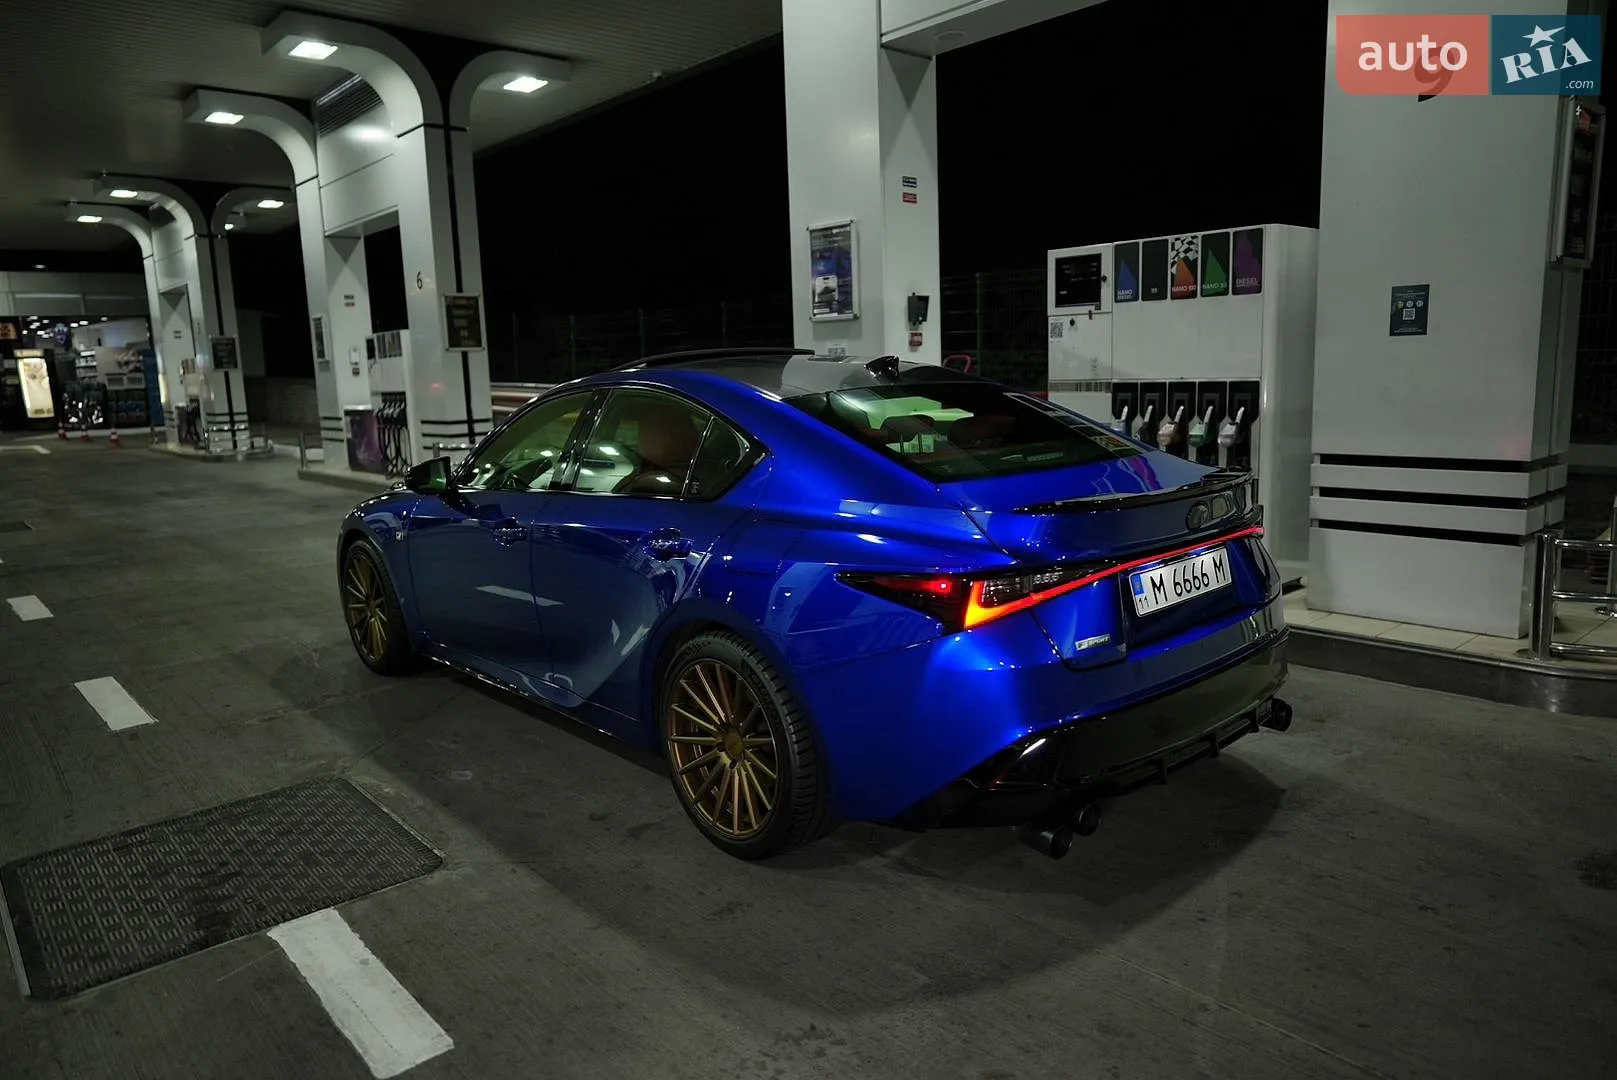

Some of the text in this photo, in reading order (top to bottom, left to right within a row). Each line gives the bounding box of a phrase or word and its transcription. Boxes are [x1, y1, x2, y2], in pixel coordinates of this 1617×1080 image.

[1413, 47, 1456, 103] 9
[416, 271, 423, 291] 6
[1150, 553, 1226, 605] M 6666 M
[1138, 595, 1150, 610] 11
